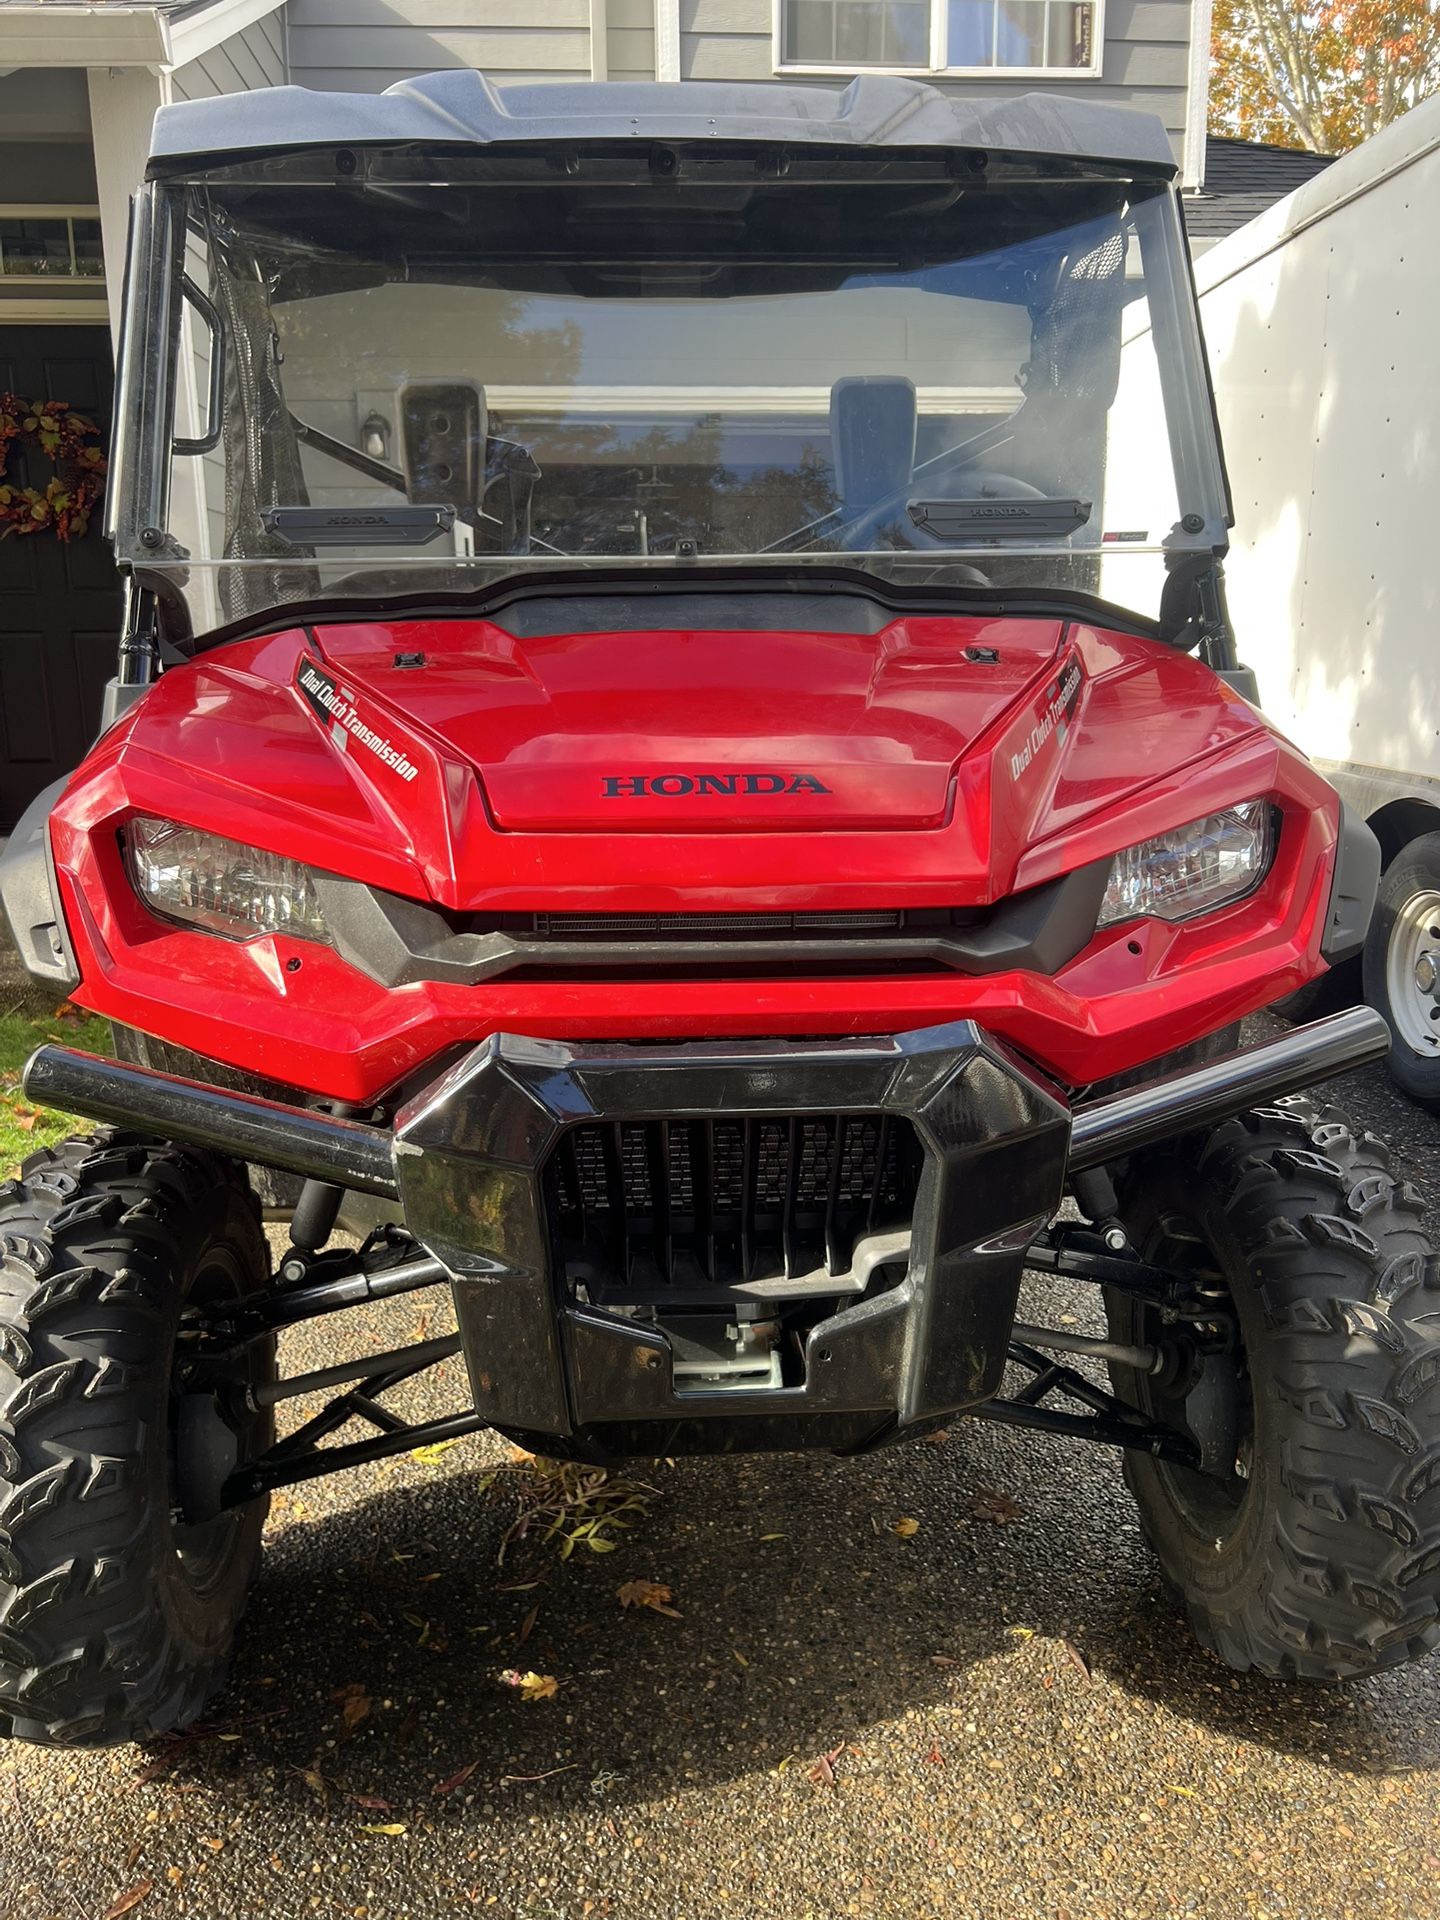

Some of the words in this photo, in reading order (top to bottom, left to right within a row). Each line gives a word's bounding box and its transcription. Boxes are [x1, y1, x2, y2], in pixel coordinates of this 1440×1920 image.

[1082, 18, 1091, 62] Tootsie
[326, 513, 390, 526] HONDA
[971, 506, 1031, 518] HONDA
[300, 668, 326, 695] Dual
[316, 685, 349, 719] Clutch
[342, 707, 419, 782] Transmission
[1011, 738, 1033, 782] Dual
[1031, 710, 1054, 755] Clutch
[1049, 665, 1082, 724] Transmission
[602, 773, 833, 797] HONDA
